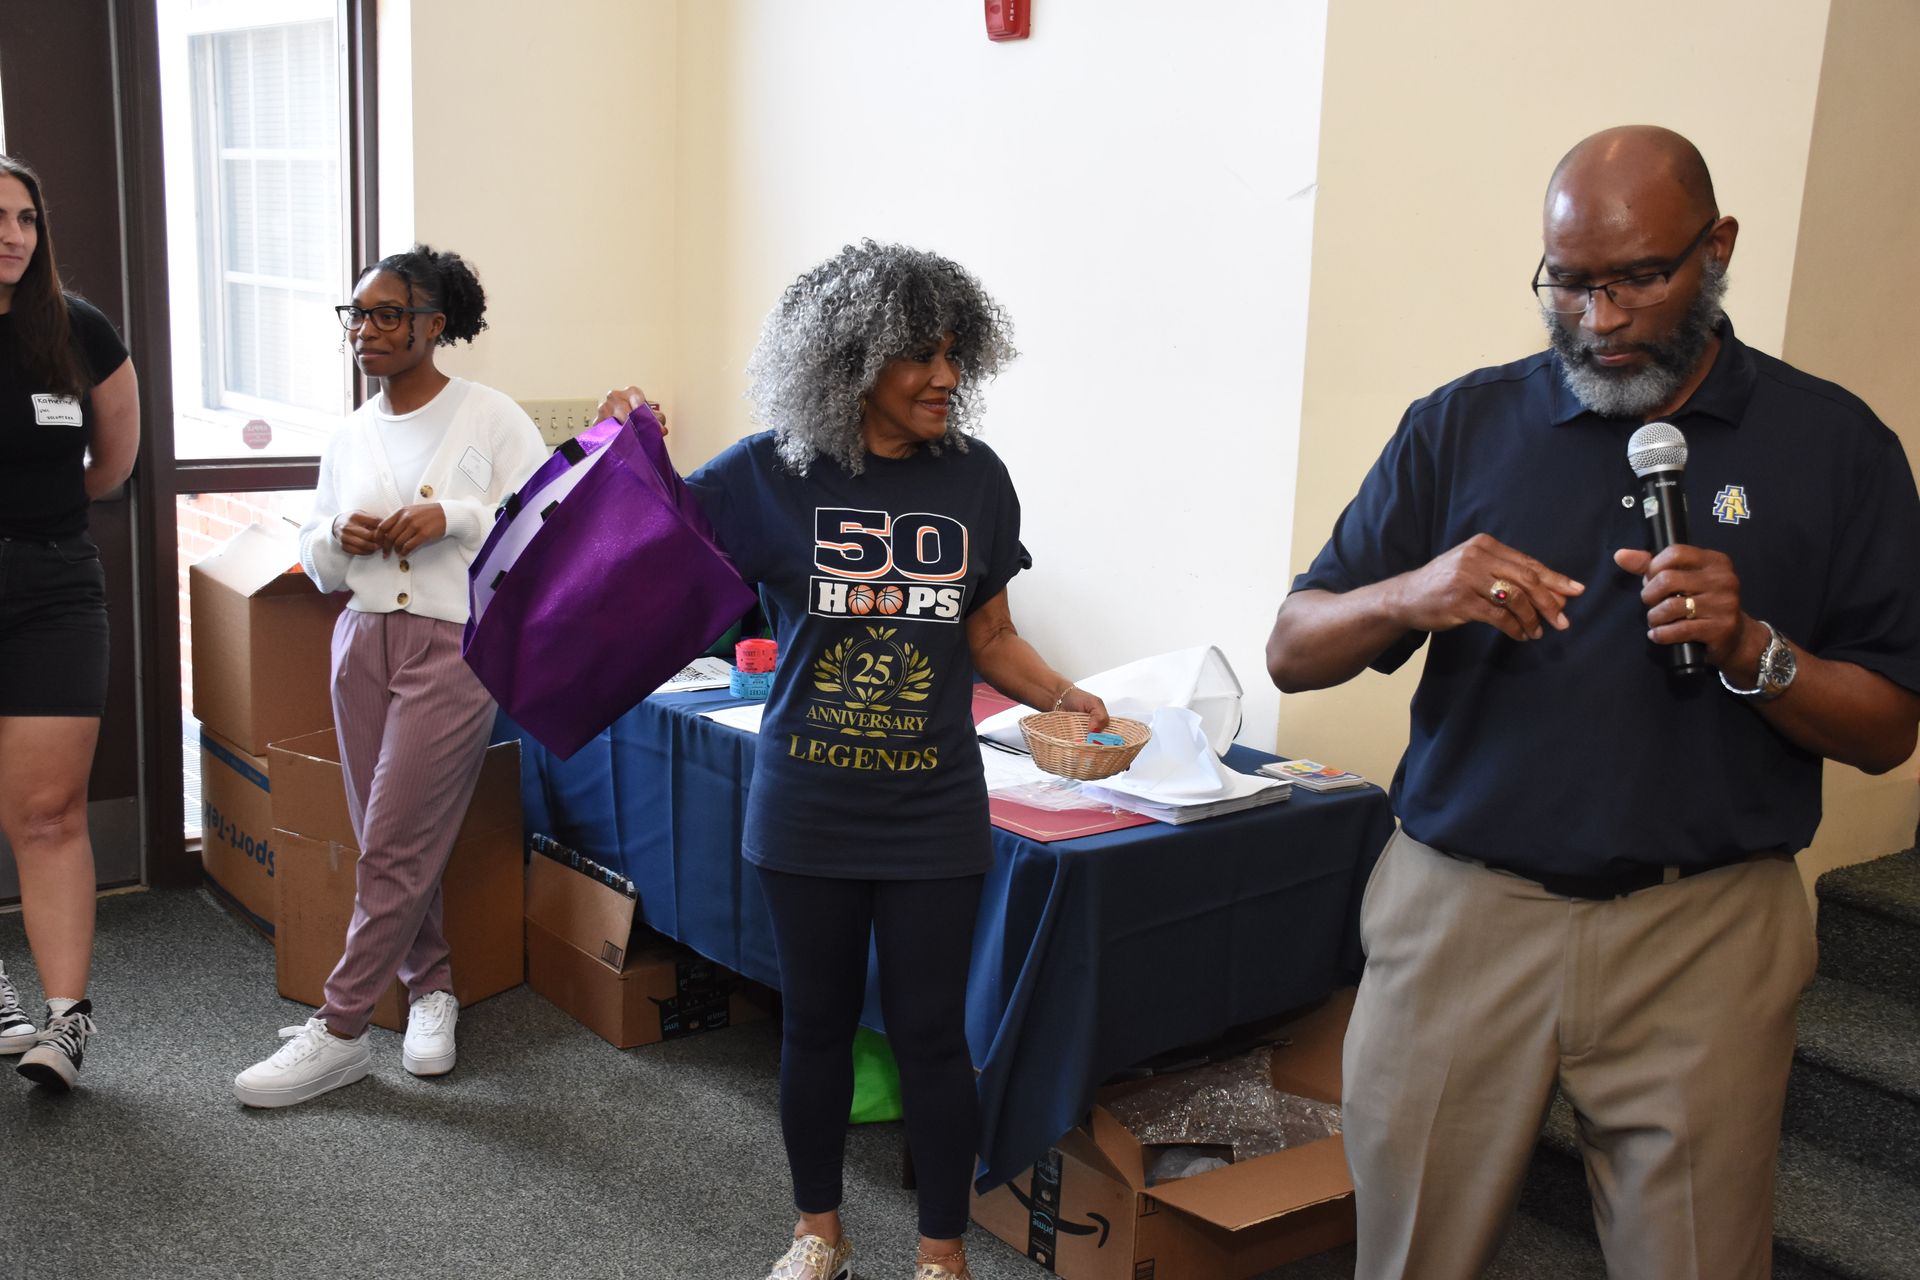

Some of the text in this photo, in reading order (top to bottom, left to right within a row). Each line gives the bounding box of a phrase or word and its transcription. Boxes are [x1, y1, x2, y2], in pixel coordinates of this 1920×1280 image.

[814, 506, 969, 582] 50
[818, 582, 960, 618] HOOPS
[806, 705, 928, 731] ANNIVERSARY
[788, 735, 939, 771] LEGENDS
[204, 799, 276, 878] Sport-Tek
